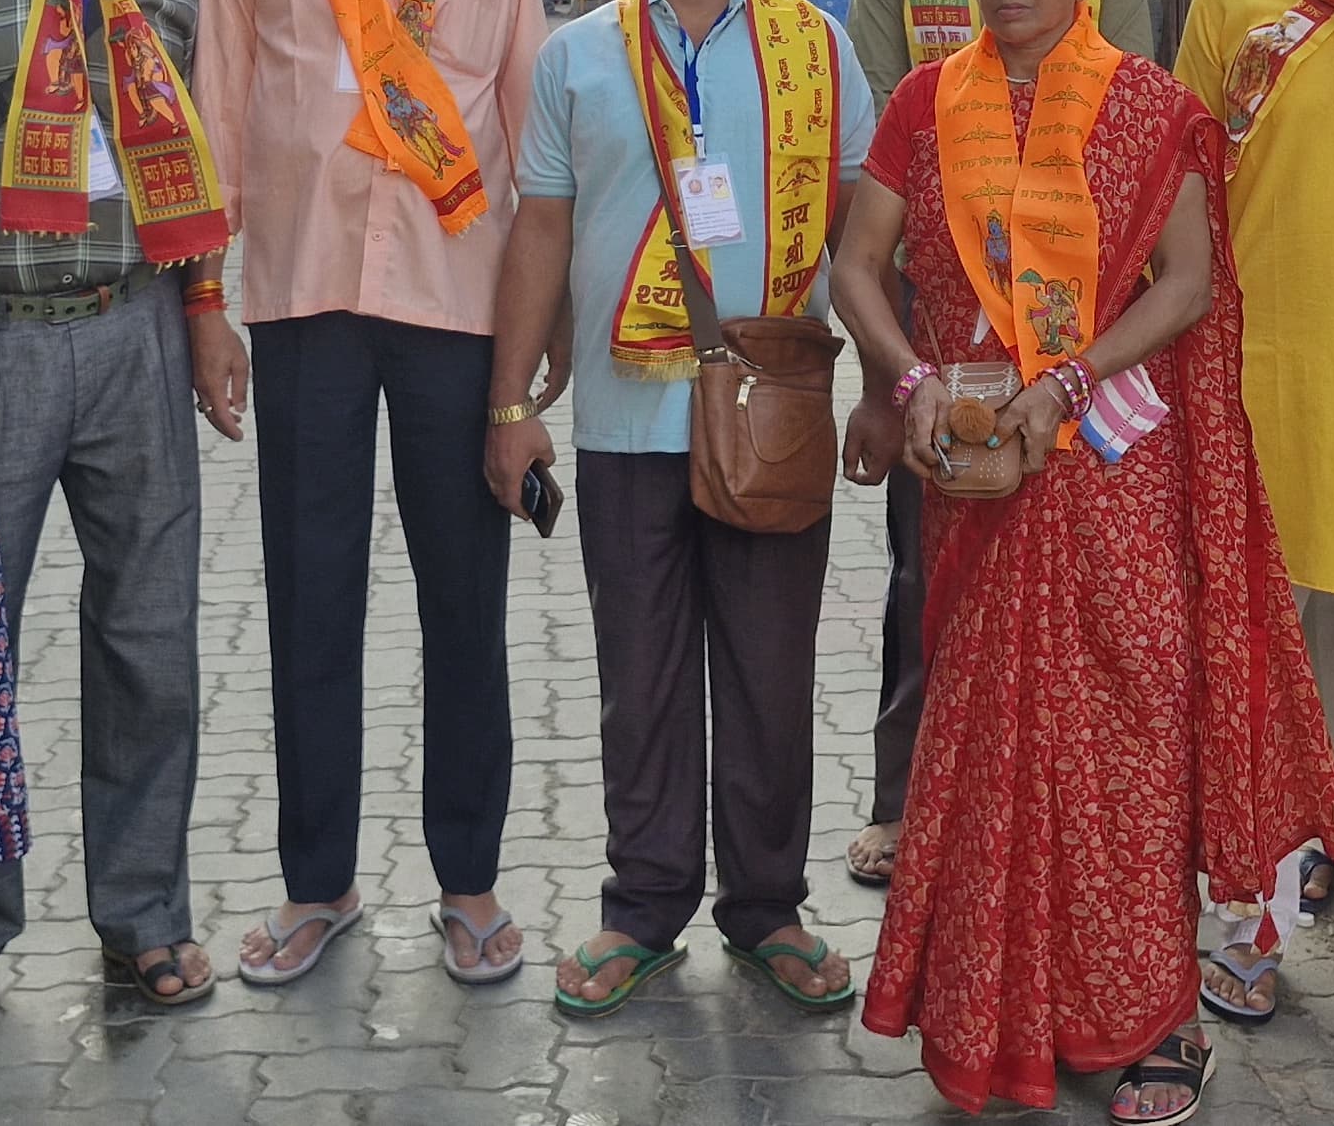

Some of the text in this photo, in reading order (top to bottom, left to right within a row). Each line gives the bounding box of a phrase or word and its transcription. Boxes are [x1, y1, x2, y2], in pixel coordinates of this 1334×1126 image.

[781, 202, 810, 231] जय
[785, 232, 804, 268] श्री
[636, 285, 686, 307] श्या
[772, 266, 814, 298] श्या
